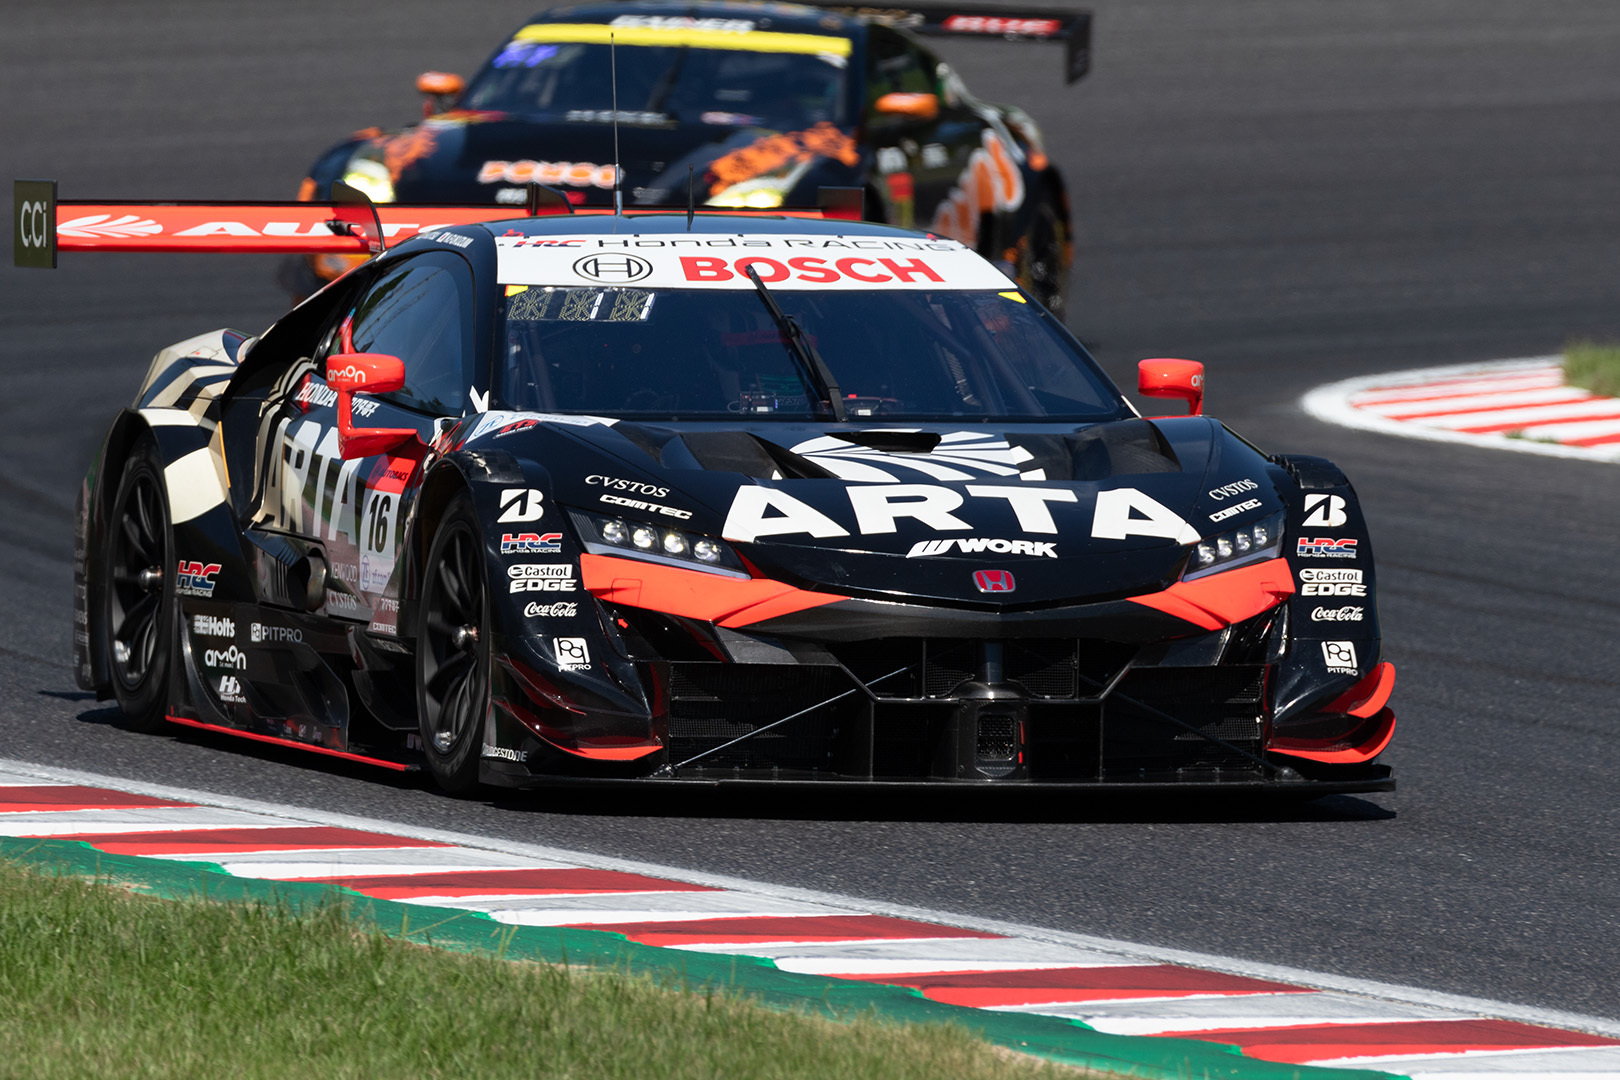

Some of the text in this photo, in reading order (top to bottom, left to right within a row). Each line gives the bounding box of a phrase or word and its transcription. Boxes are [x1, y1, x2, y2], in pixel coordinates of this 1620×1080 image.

[513, 238, 955, 252] HRC Honda RACING
[678, 256, 946, 283] BOSCH
[327, 365, 366, 383] amon
[295, 382, 338, 408] HONDA
[251, 416, 364, 546] ARTA
[584, 474, 671, 498] CVSTOS
[1208, 478, 1259, 501] CVSTOS
[599, 494, 693, 520] COMTEC
[722, 484, 1201, 546] ARTA
[1208, 498, 1263, 523] COMTEC
[368, 493, 392, 553] 16
[500, 532, 563, 551] HRC
[955, 538, 1059, 559] WORK
[1296, 537, 1358, 554] HRC
[175, 559, 223, 590] HRC
[524, 566, 568, 577] Castrol
[1316, 570, 1359, 581] Castrol
[509, 578, 578, 594] EDGE
[1301, 583, 1368, 597] EDGE
[208, 616, 236, 638] Holts
[262, 625, 303, 642] PITPRO
[372, 621, 397, 634] COMTEC
[204, 644, 247, 670] amon
[1327, 667, 1359, 677] PITPRO
